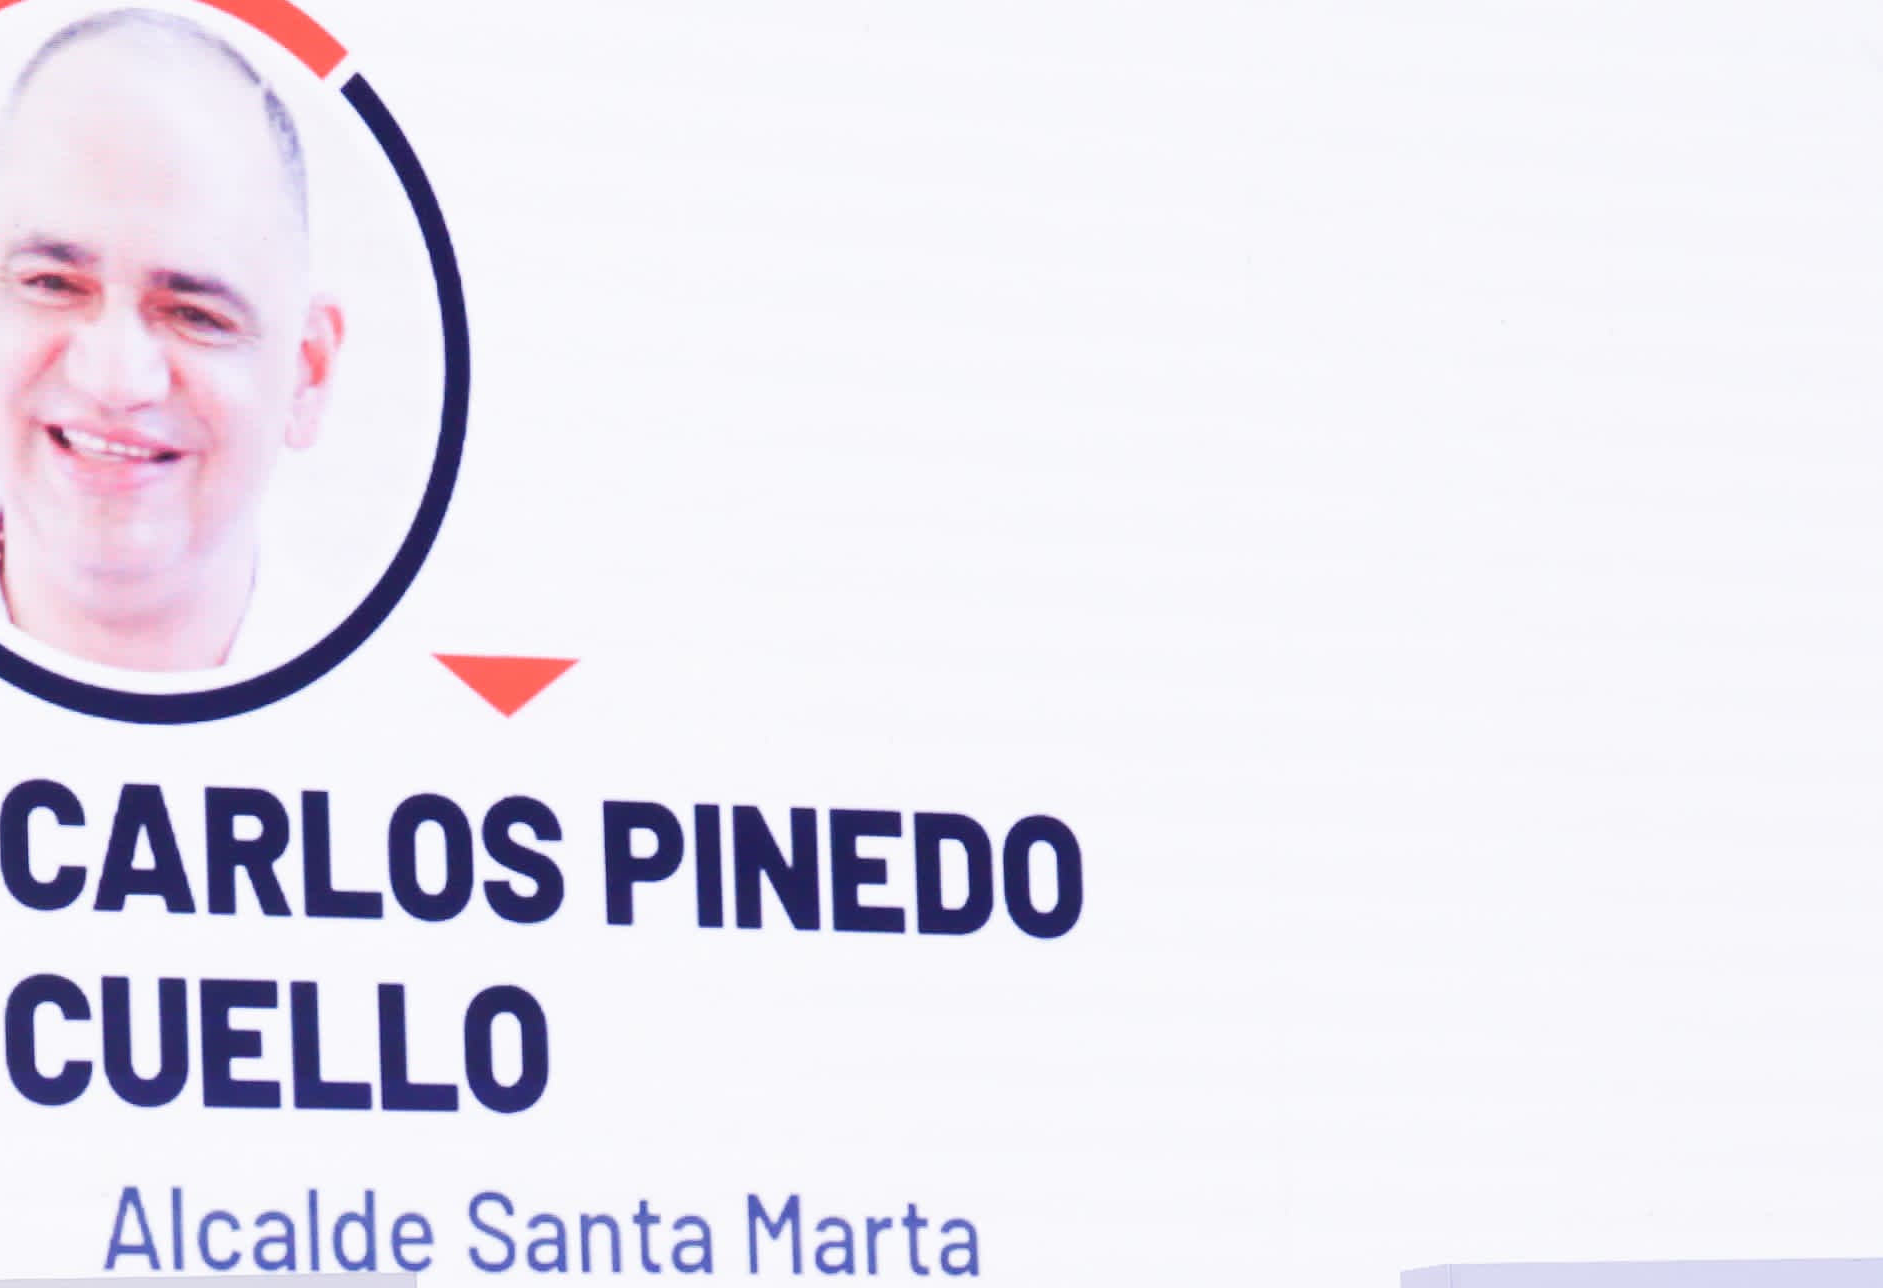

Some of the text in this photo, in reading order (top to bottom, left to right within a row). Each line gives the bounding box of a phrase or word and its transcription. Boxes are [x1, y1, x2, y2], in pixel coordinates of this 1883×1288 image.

[602, 799, 1084, 940] PINEDO
[4, 973, 550, 1115] CUELLO
[104, 1186, 981, 1278] Alcalde Santa Marta
